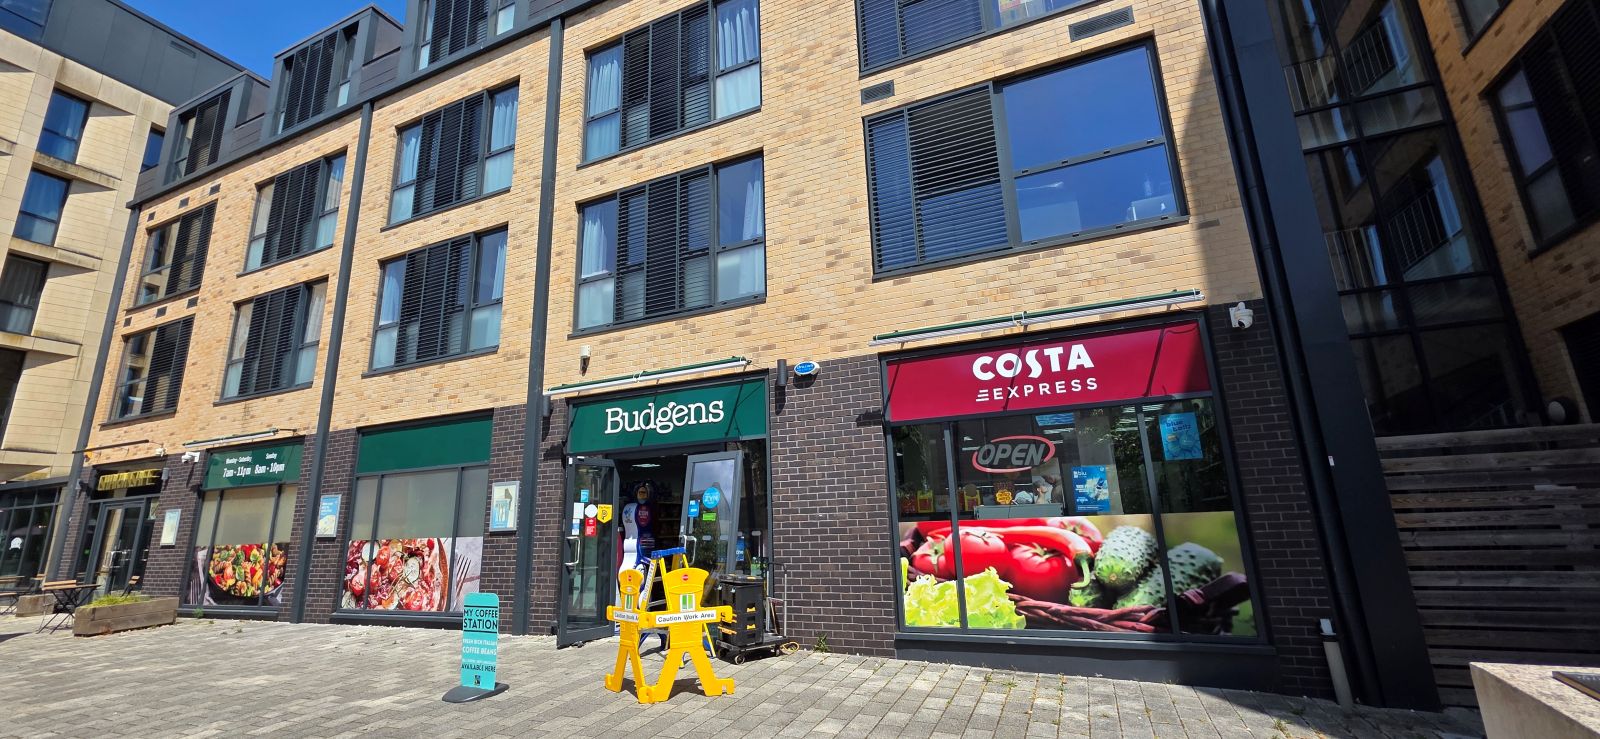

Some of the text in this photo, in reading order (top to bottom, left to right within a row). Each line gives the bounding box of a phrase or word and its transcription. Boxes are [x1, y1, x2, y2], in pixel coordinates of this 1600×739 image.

[972, 343, 1095, 381] COSTA
[993, 377, 1098, 400] EXPRESS
[604, 400, 725, 434] Budgens
[977, 443, 1046, 466] OPEN
[464, 609, 498, 618] MY COFFEE
[657, 615, 682, 623] Caution
[684, 614, 699, 622] Work
[463, 618, 498, 630] STATION
[462, 646, 480, 654] COFFEE
